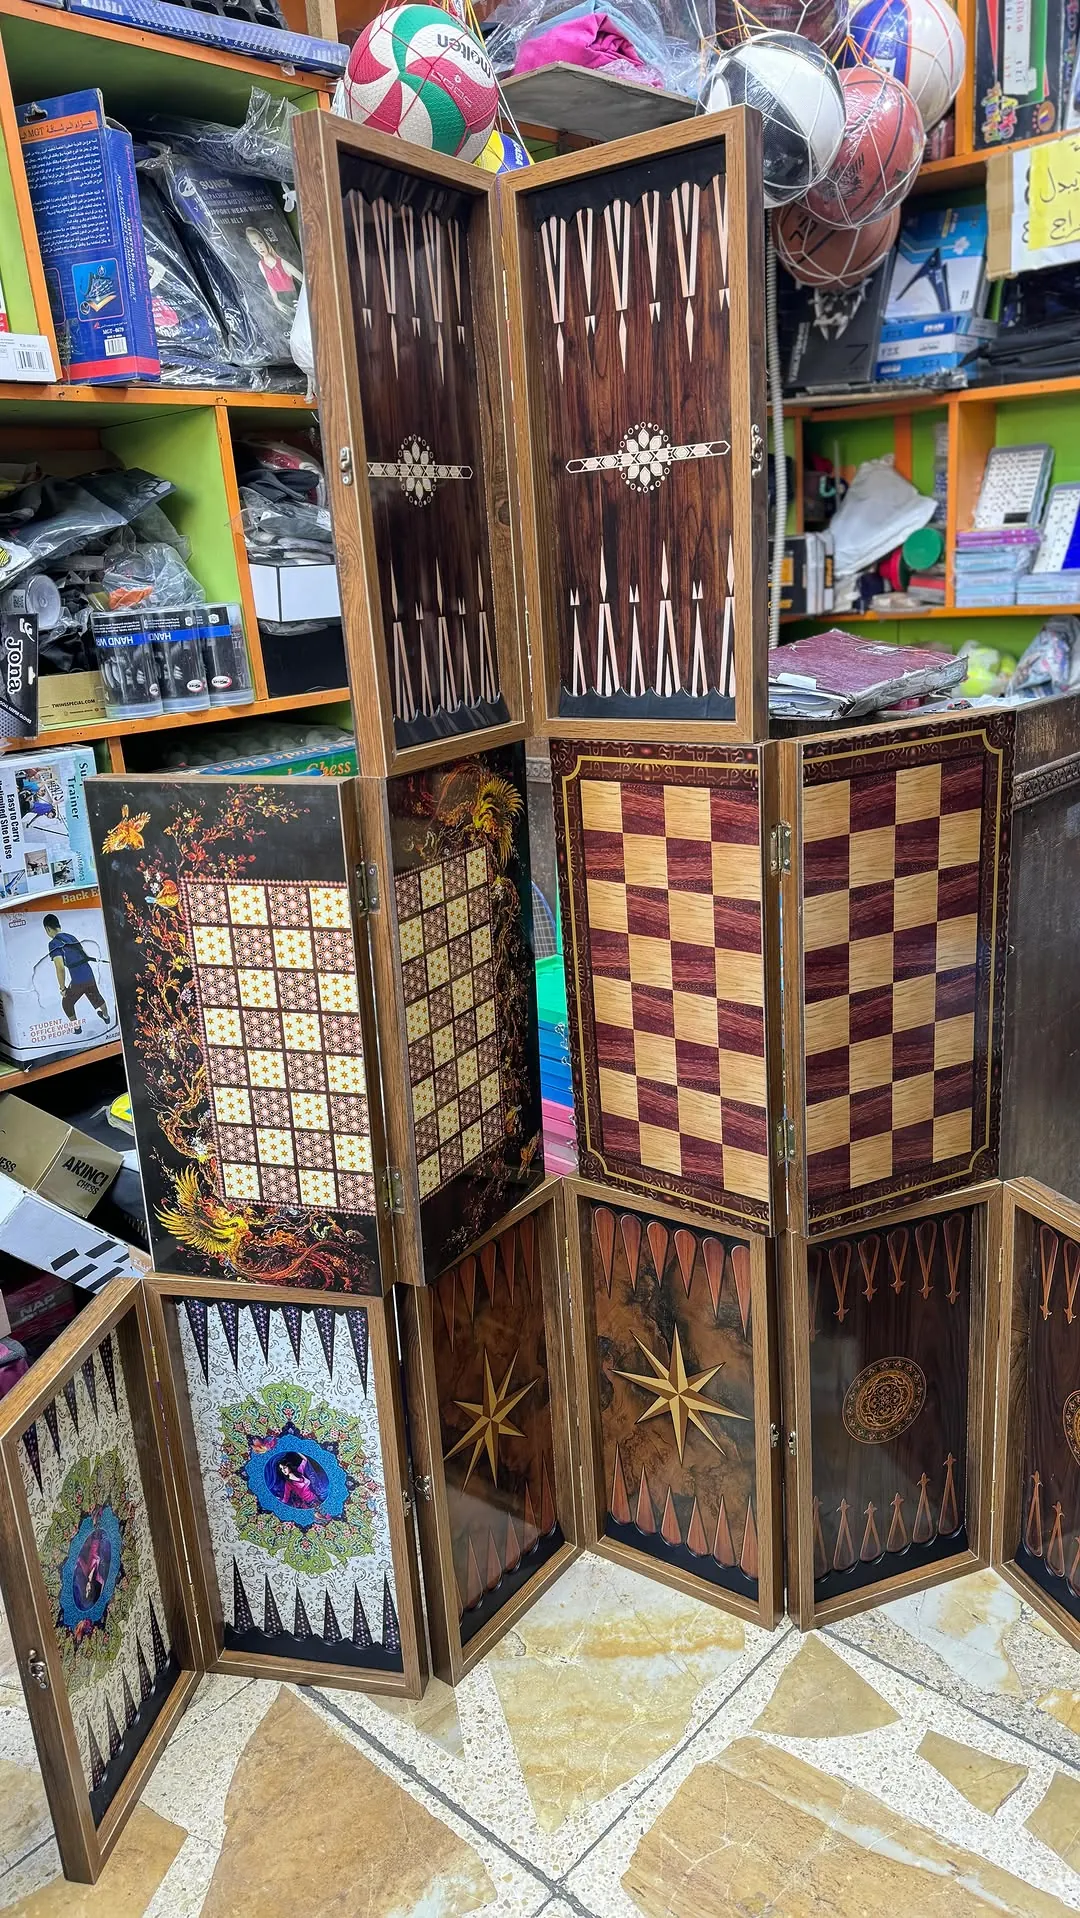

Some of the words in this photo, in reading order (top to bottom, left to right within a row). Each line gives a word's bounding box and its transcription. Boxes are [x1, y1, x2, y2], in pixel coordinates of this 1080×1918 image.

[437, 33, 492, 79] molten
[28, 126, 45, 137] MGT
[200, 179, 233, 190] SUNEX
[107, 636, 134, 646] HAND
[7, 794, 16, 812] Easy
[68, 776, 80, 820] Trainer
[1, 819, 9, 835] Site
[11, 821, 20, 844] Carry
[3, 835, 10, 843] to
[4, 844, 12, 860] Use
[61, 890, 89, 904] Back
[91, 888, 100, 898] E
[29, 1018, 62, 1031] STUDENT
[30, 1026, 56, 1038] OFFICE
[57, 1018, 86, 1031] WORKER
[31, 1035, 47, 1044] OLD
[62, 1156, 109, 1188] AKINCI
[76, 1179, 100, 1195] CHESS
